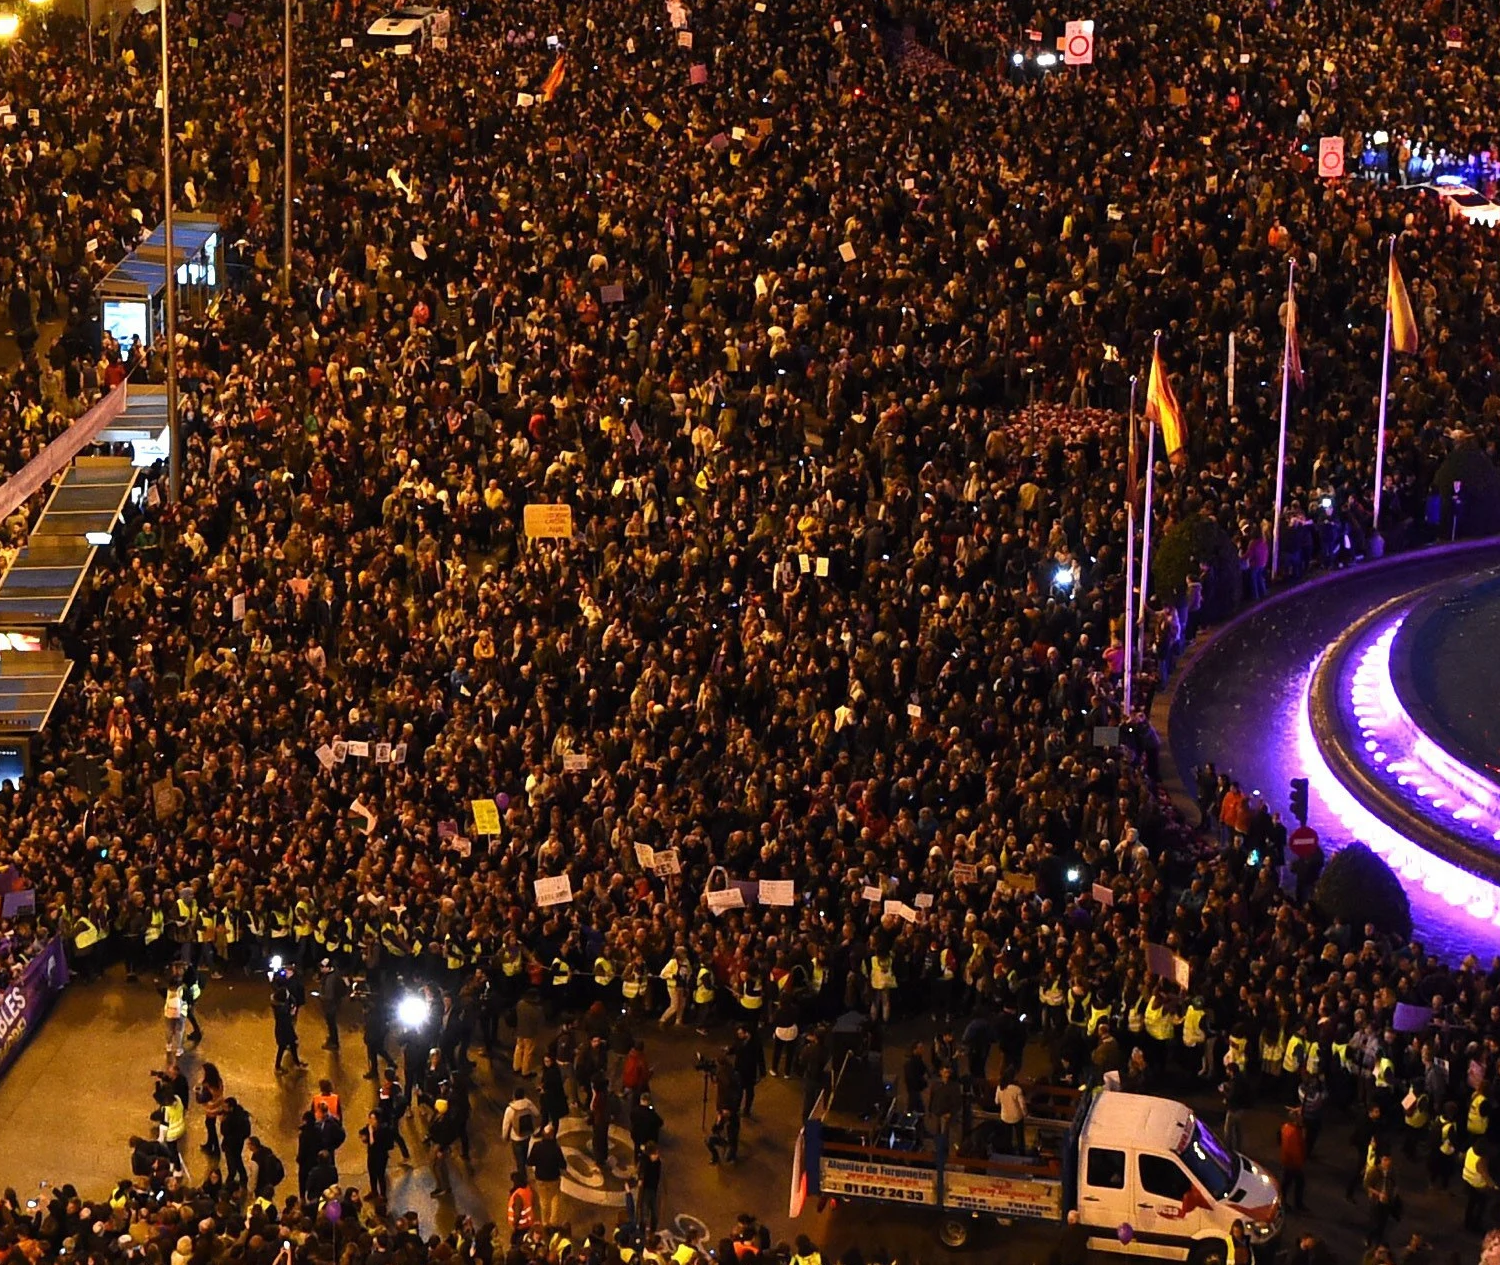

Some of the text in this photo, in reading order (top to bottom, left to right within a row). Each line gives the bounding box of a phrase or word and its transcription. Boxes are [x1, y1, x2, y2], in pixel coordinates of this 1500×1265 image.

[866, 1164, 878, 1175] de
[861, 1185, 888, 1198] 642
[890, 1187, 904, 1200] 24
[906, 1189, 924, 1201] 33
